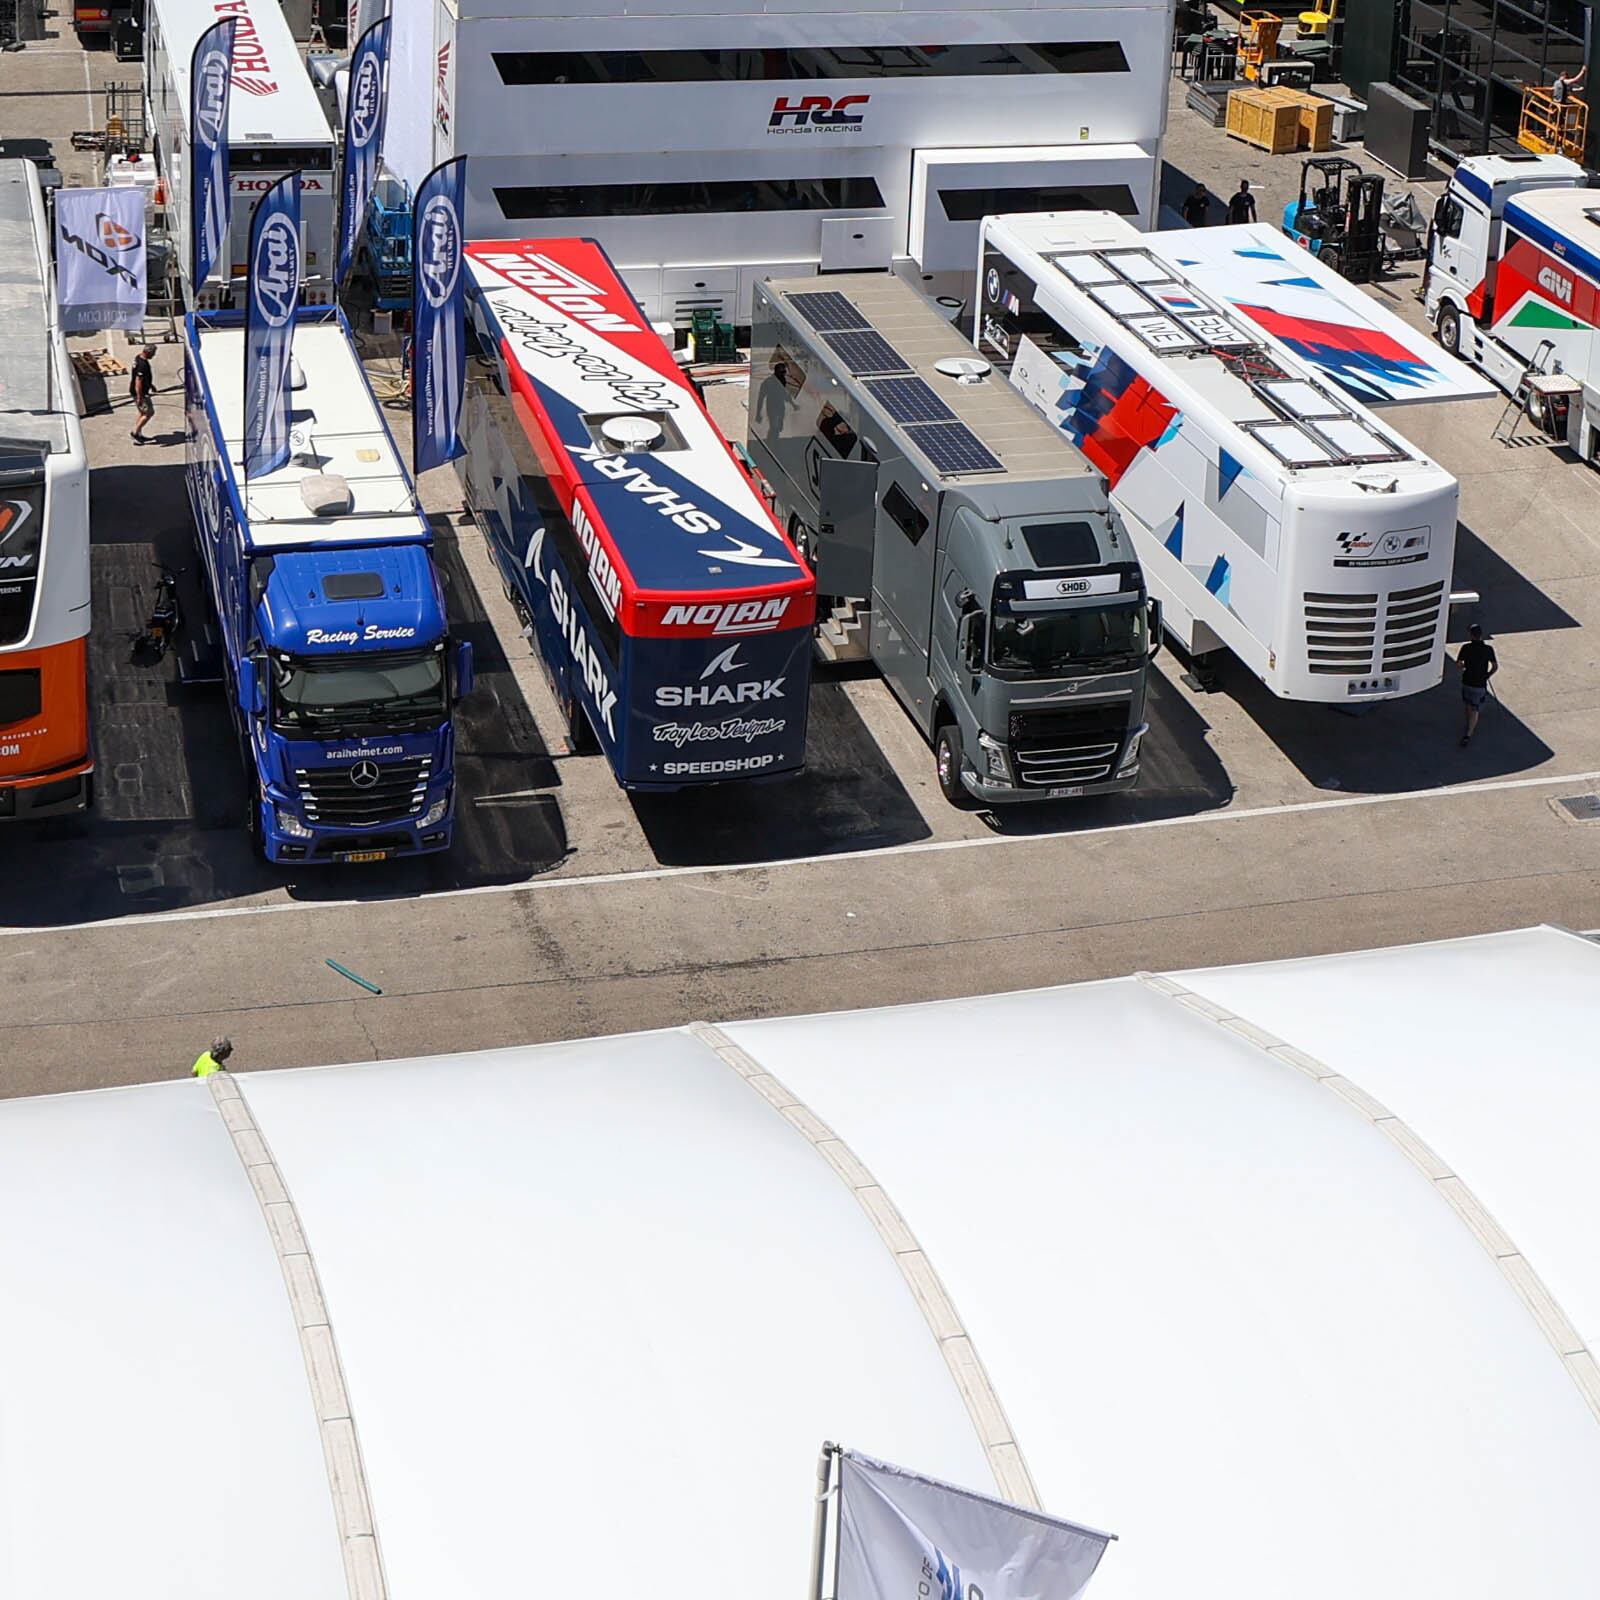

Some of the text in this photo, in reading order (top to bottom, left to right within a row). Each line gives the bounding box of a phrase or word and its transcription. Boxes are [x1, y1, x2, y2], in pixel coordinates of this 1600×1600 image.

[214, 0, 272, 73] HONDA
[352, 62, 378, 139] Arai
[767, 94, 871, 127] HRC
[766, 125, 863, 135] Honda RACING
[259, 223, 295, 314] Arai
[287, 246, 296, 290] HELMET
[419, 203, 453, 296] Arai
[473, 251, 644, 332] NOLAN
[1537, 266, 1573, 304] GIVI
[607, 373, 681, 411] Troy
[562, 443, 722, 535] SHARK
[571, 496, 624, 624] NOLAN
[1060, 581, 1087, 592] SHOEI
[306, 624, 416, 645] Racing Service
[659, 596, 792, 635] NOLAN
[549, 577, 619, 742] SHARK
[655, 676, 786, 707] SHARK
[653, 717, 786, 748] Troy Lee Designs
[326, 744, 404, 760] araihelmet.com
[663, 755, 774, 776] SPEEDSHOP
